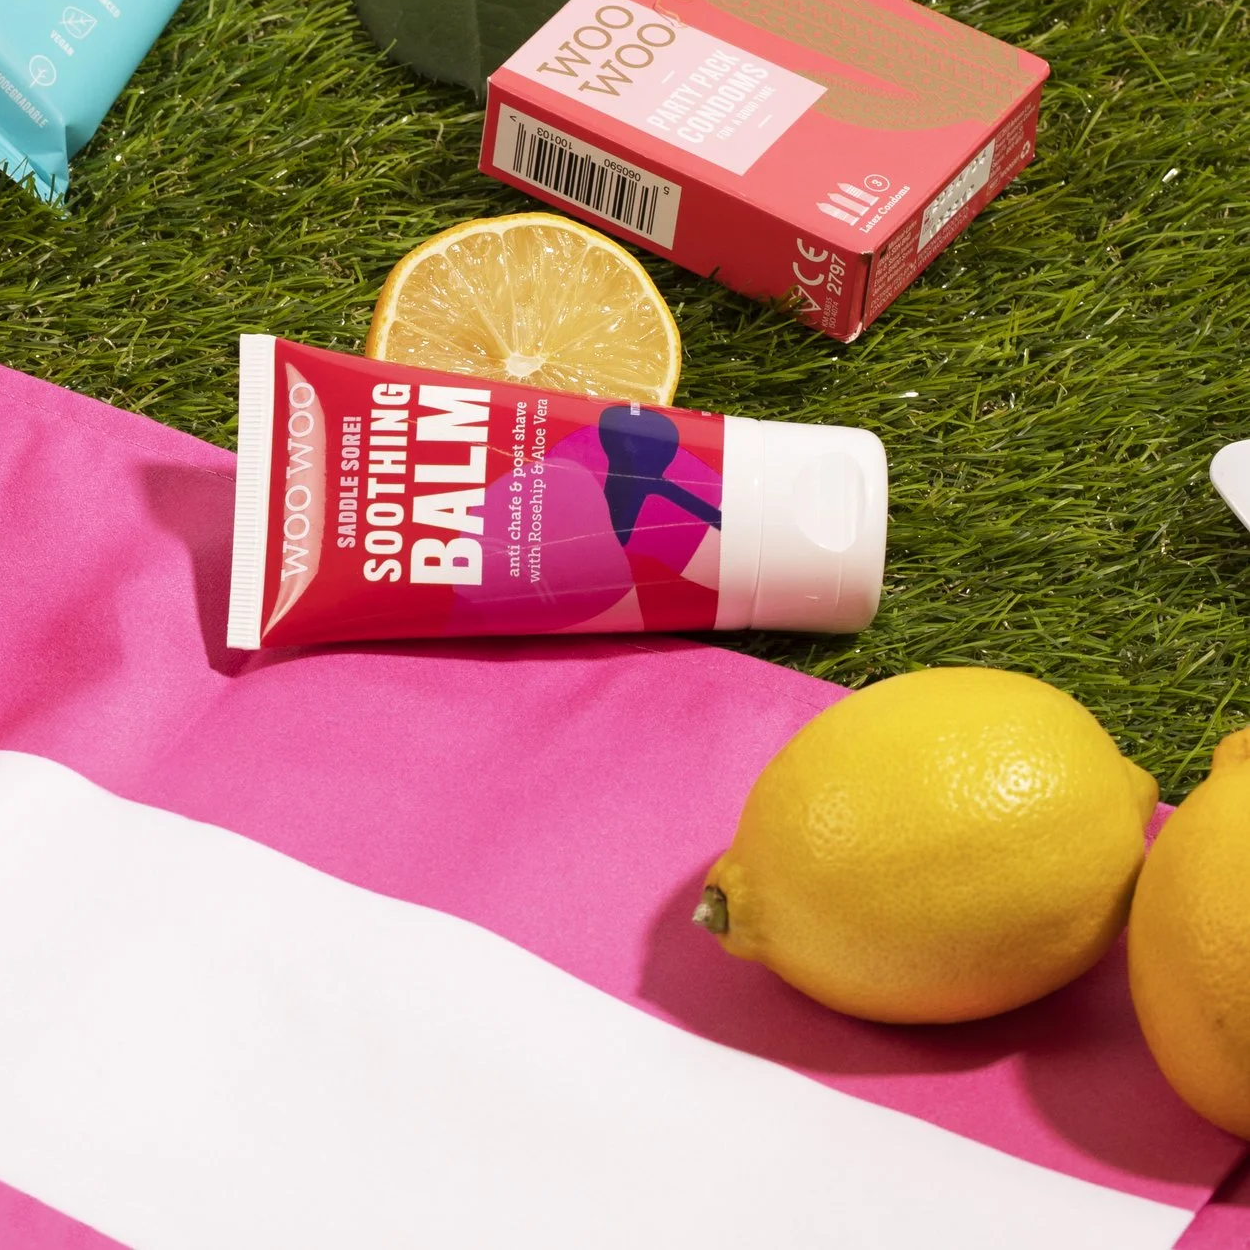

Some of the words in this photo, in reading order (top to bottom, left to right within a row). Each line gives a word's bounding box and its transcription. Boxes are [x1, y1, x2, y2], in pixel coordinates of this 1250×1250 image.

[50, 30, 75, 56] VEGAN
[536, 5, 634, 78] WOO
[578, 23, 676, 97] WOO
[646, 82, 698, 132] PARTY
[689, 50, 741, 88] PACK
[676, 62, 770, 144] CONDOMS
[756, 86, 776, 107] TIME
[537, 127, 572, 150] 100103
[604, 158, 641, 182] 060590
[663, 186, 670, 196] 5
[872, 178, 882, 188] 3
[859, 214, 883, 234] Latex
[878, 185, 910, 216] Condoms
[826, 253, 846, 296] 2797
[286, 382, 316, 478] WOO
[512, 401, 527, 444] shave
[534, 398, 548, 426] Vera
[341, 416, 362, 471] SORE!
[513, 447, 527, 478] post
[530, 428, 546, 460] Aloe
[363, 383, 410, 582] SOOTHING
[410, 384, 492, 585] BALM
[510, 480, 522, 492] &
[530, 463, 544, 476] &
[337, 476, 358, 549] SADDLE
[508, 495, 522, 540] chafe
[528, 478, 546, 543] Rosehip
[280, 484, 312, 582] WOO
[508, 544, 520, 577] anti
[528, 551, 540, 584] with
